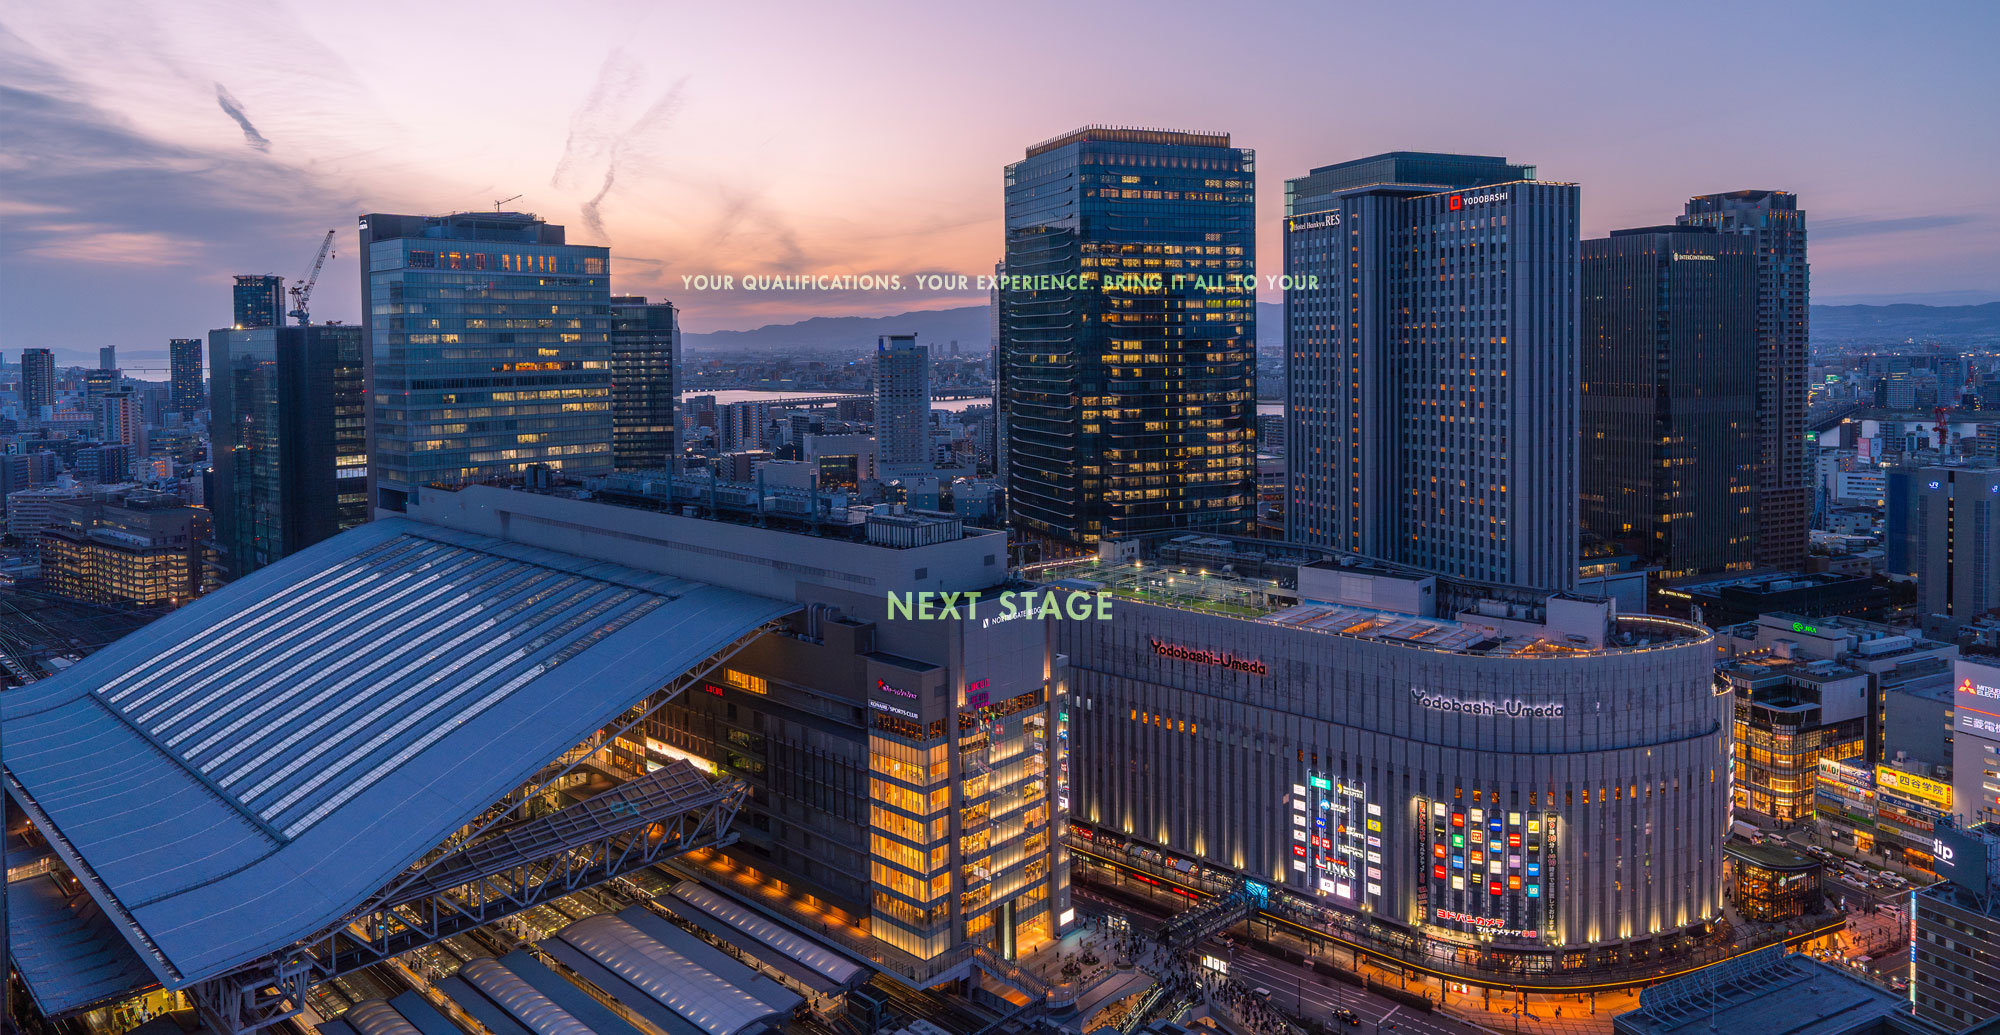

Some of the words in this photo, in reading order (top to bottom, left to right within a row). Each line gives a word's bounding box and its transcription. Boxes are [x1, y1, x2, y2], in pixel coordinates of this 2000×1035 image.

[1463, 192, 1508, 205] YODOBASHI
[1294, 223, 1306, 231] Hotel
[1307, 221, 1325, 229] Hankyu
[1928, 481, 1939, 489] JR
[1013, 610, 1027, 620] GATE
[1804, 625, 1817, 634] JRA
[1151, 638, 1266, 675] Yodobashi-Umeda
[1411, 689, 1564, 717] Yodobashi-Umeda
[1900, 775, 1944, 796] 四谷学院
[1436, 908, 1506, 928] ヨドバシカメラ
